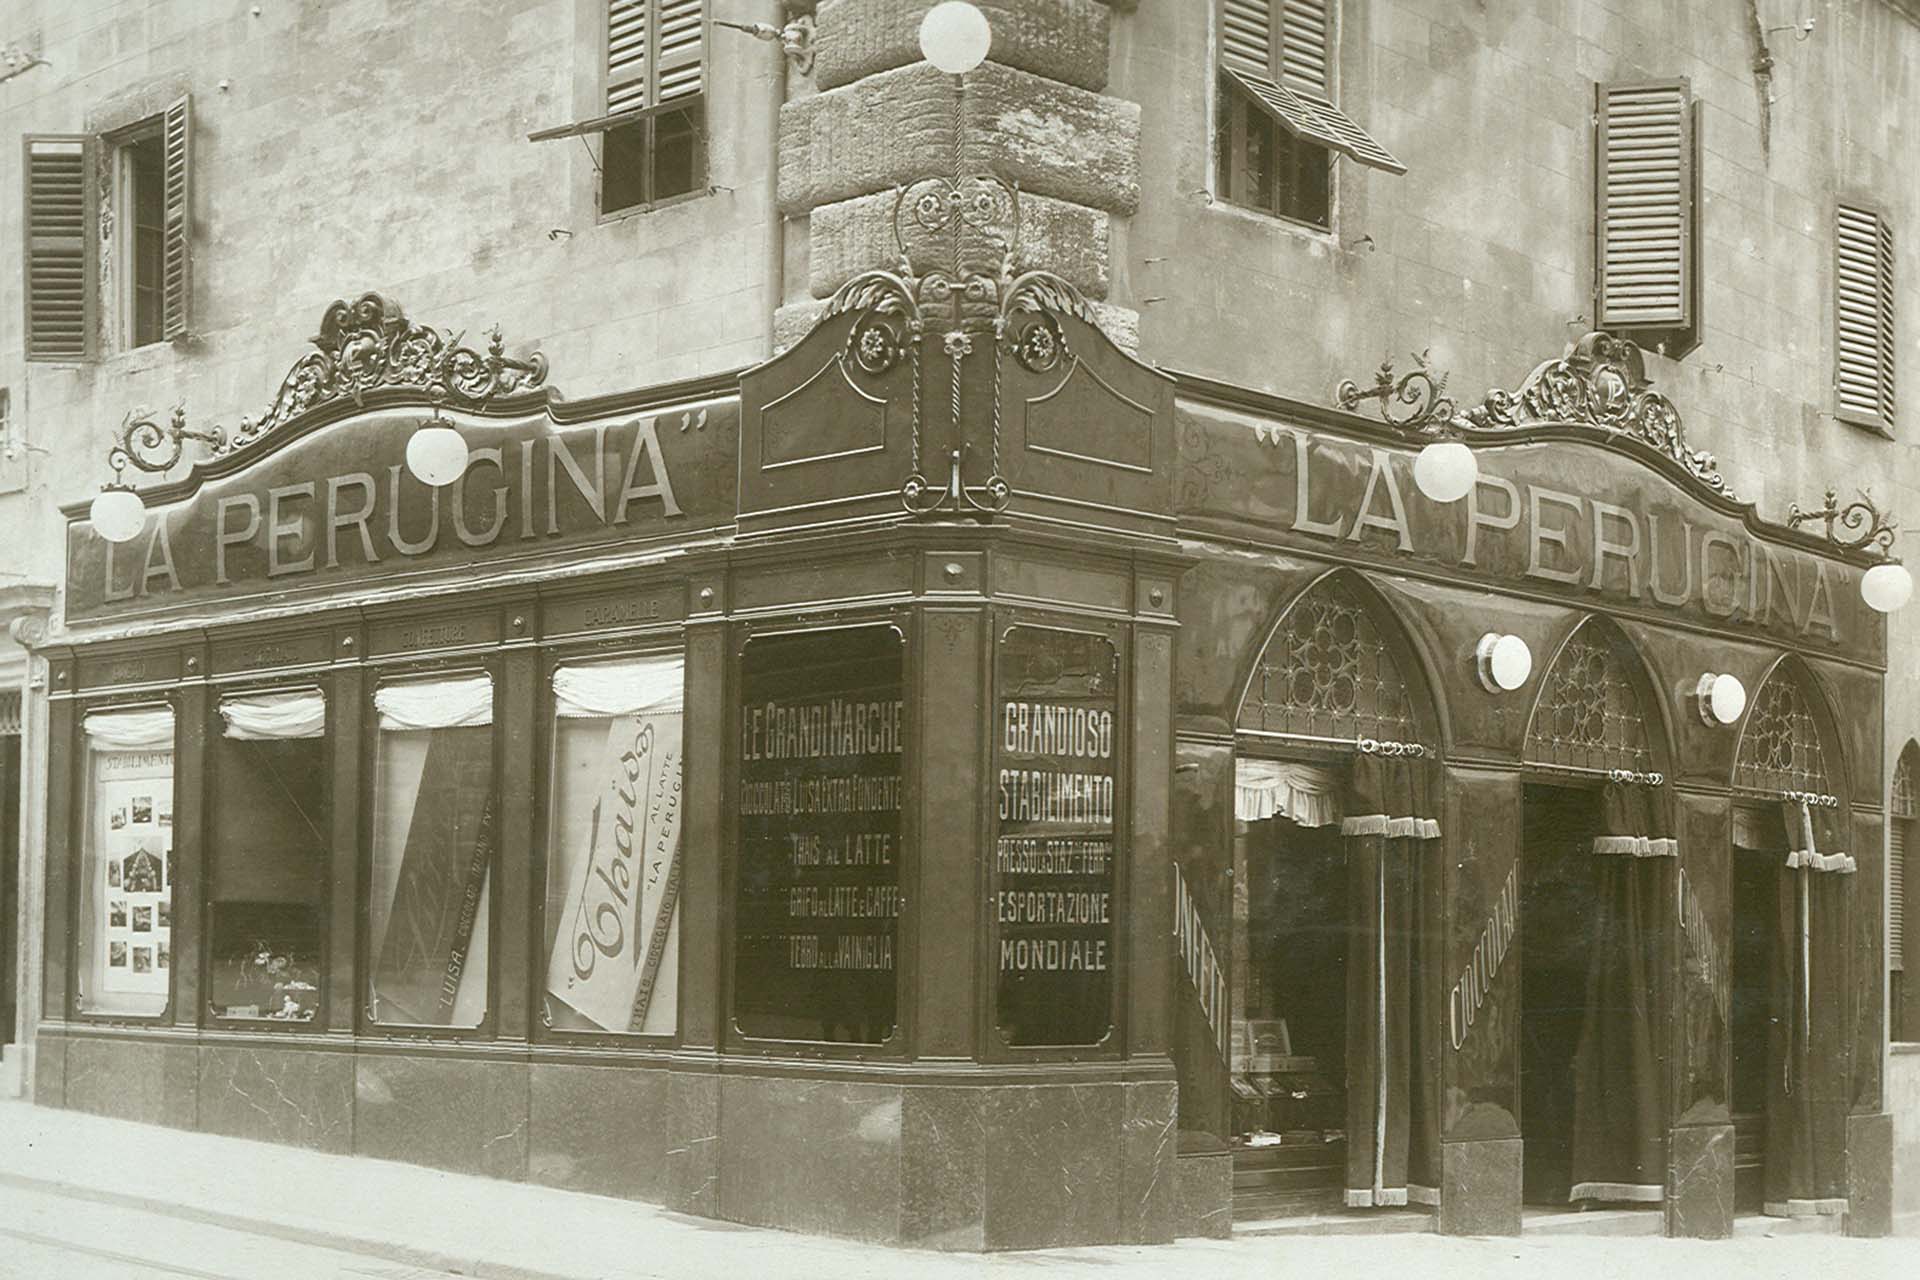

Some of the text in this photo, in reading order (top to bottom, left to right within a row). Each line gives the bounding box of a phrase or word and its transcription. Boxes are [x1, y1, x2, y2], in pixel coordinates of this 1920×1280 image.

[743, 699, 903, 760] LE GRANDI MARCHE
[1005, 702, 1112, 758] GRANDIOSO
[650, 751, 673, 825] AL LATTE
[999, 768, 1113, 824] STABILIMENTO
[845, 834, 891, 865] LATTE
[997, 839, 1036, 873] PRESSO
[998, 891, 1110, 924] ESPORTAZIONE
[1000, 940, 1107, 970] MONDIALE
